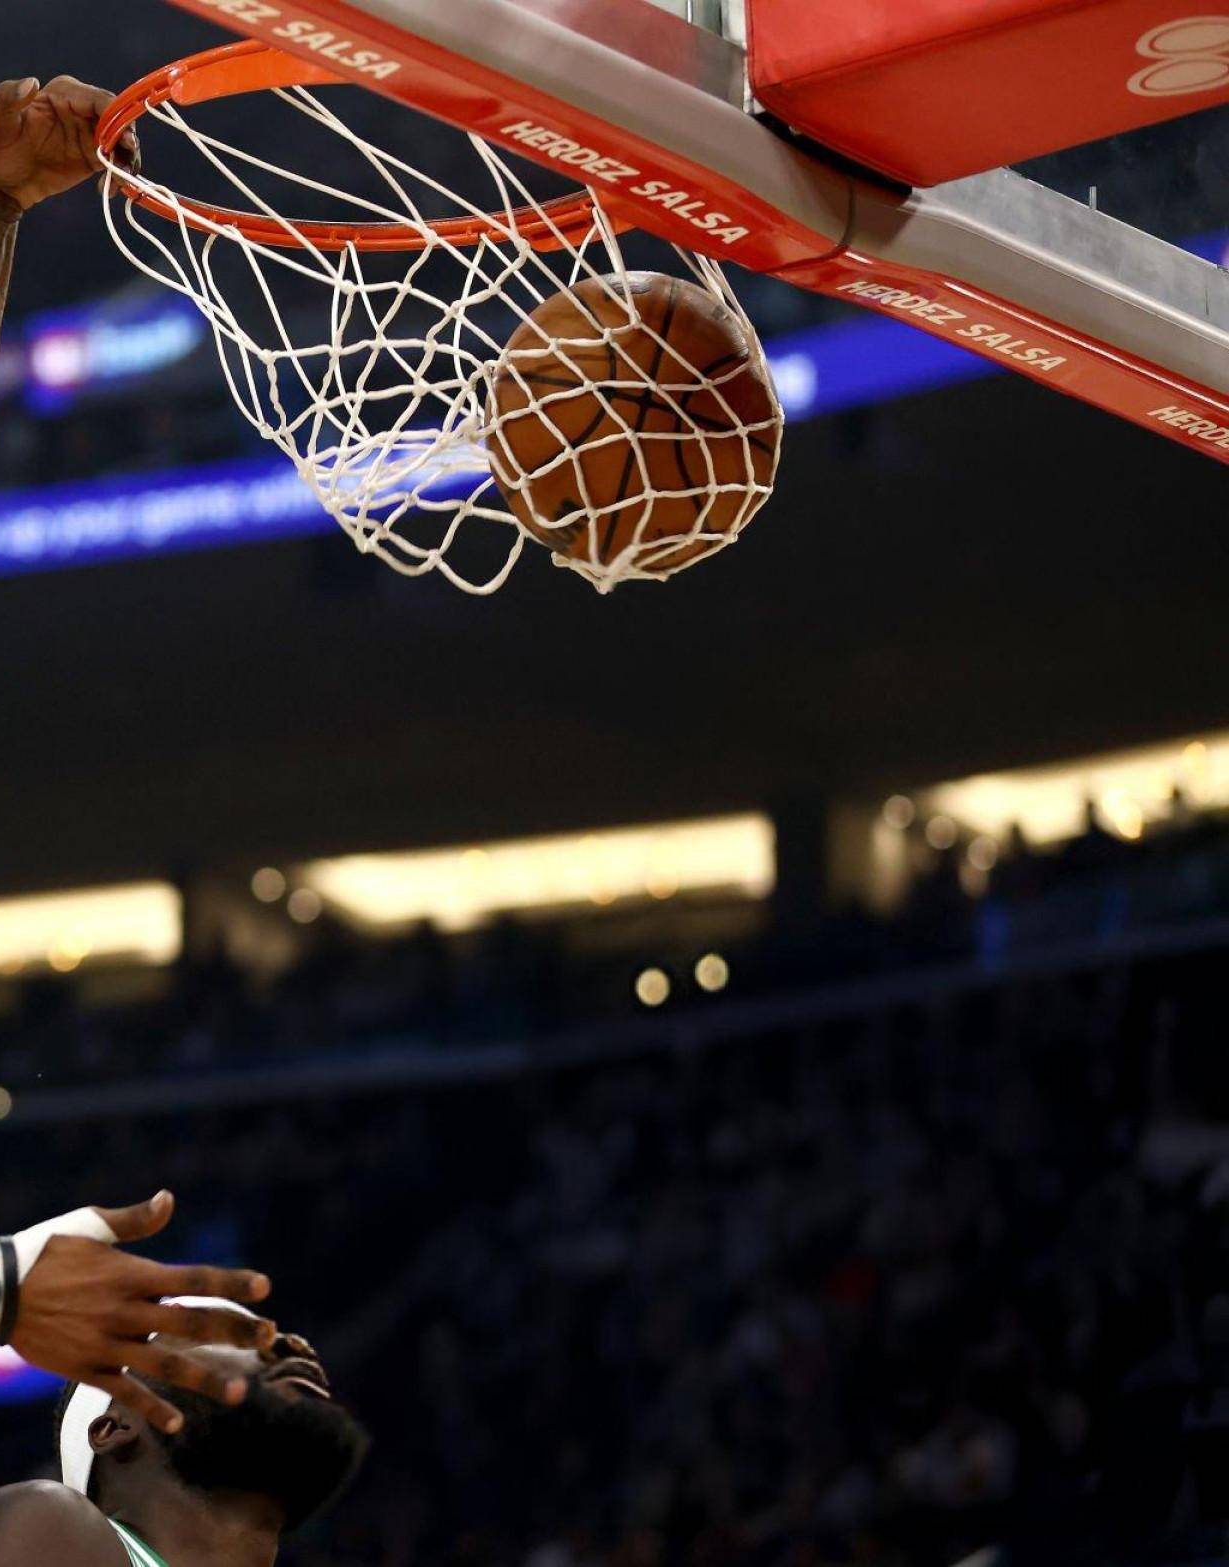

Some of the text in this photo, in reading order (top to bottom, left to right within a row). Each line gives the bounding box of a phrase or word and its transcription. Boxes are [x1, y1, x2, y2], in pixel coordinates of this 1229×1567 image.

[273, 21, 402, 80] SALSA
[500, 121, 750, 245] HERDEZ SALSA
[836, 281, 1067, 372] HERDEZ SALSA
